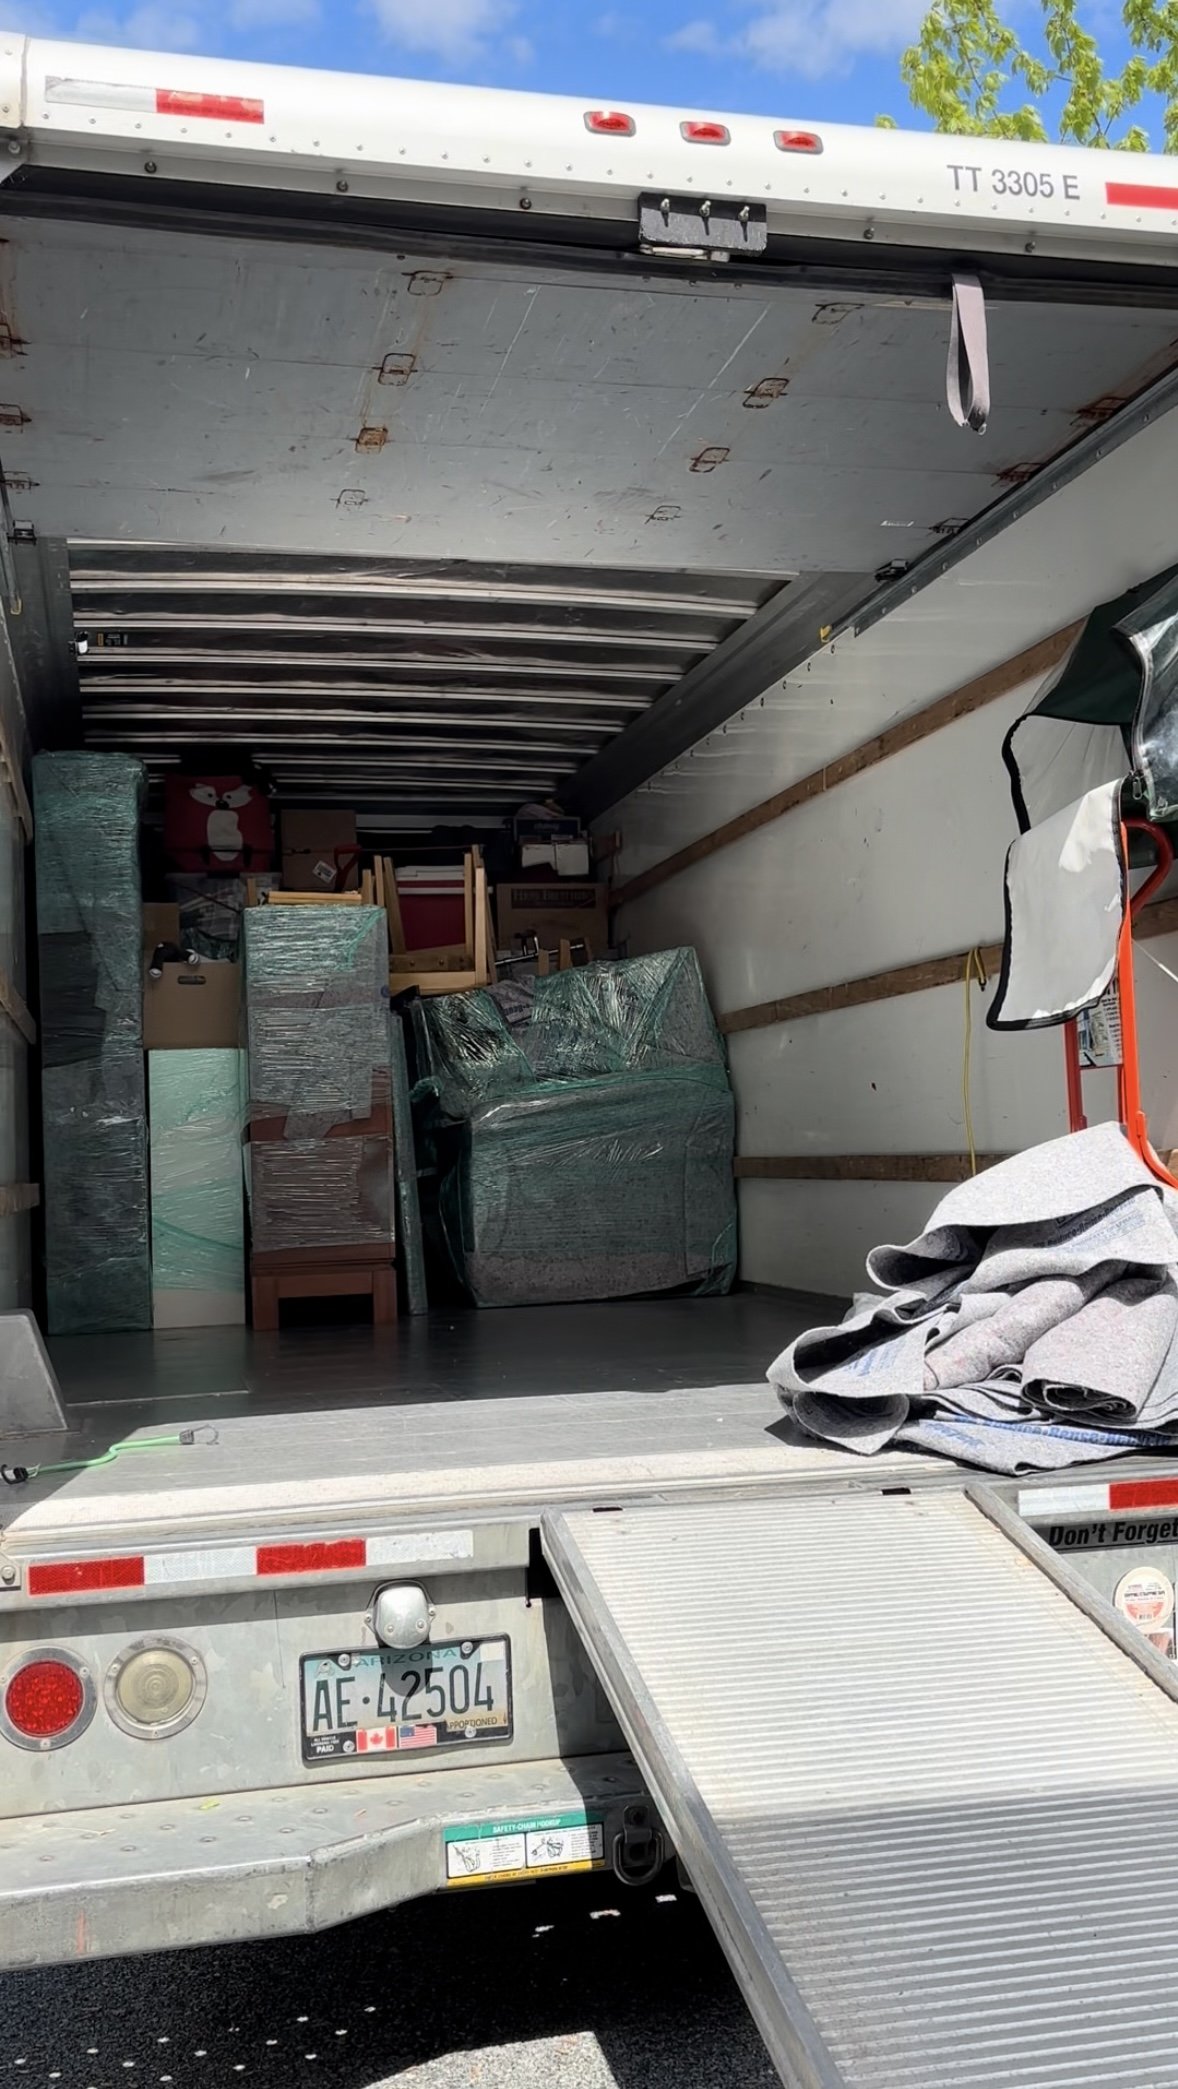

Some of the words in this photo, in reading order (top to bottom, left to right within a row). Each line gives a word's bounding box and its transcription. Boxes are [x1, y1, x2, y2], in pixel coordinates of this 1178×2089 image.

[947, 164, 982, 192] TT
[991, 169, 1054, 198] 3305
[1063, 175, 1080, 200] E
[1050, 1523, 1106, 1546] Don't
[1112, 1517, 1178, 1544] Forget
[355, 1650, 457, 1667] ARIZONA
[449, 1717, 498, 1730] PPORTIONED
[316, 1744, 335, 1754] PAID
